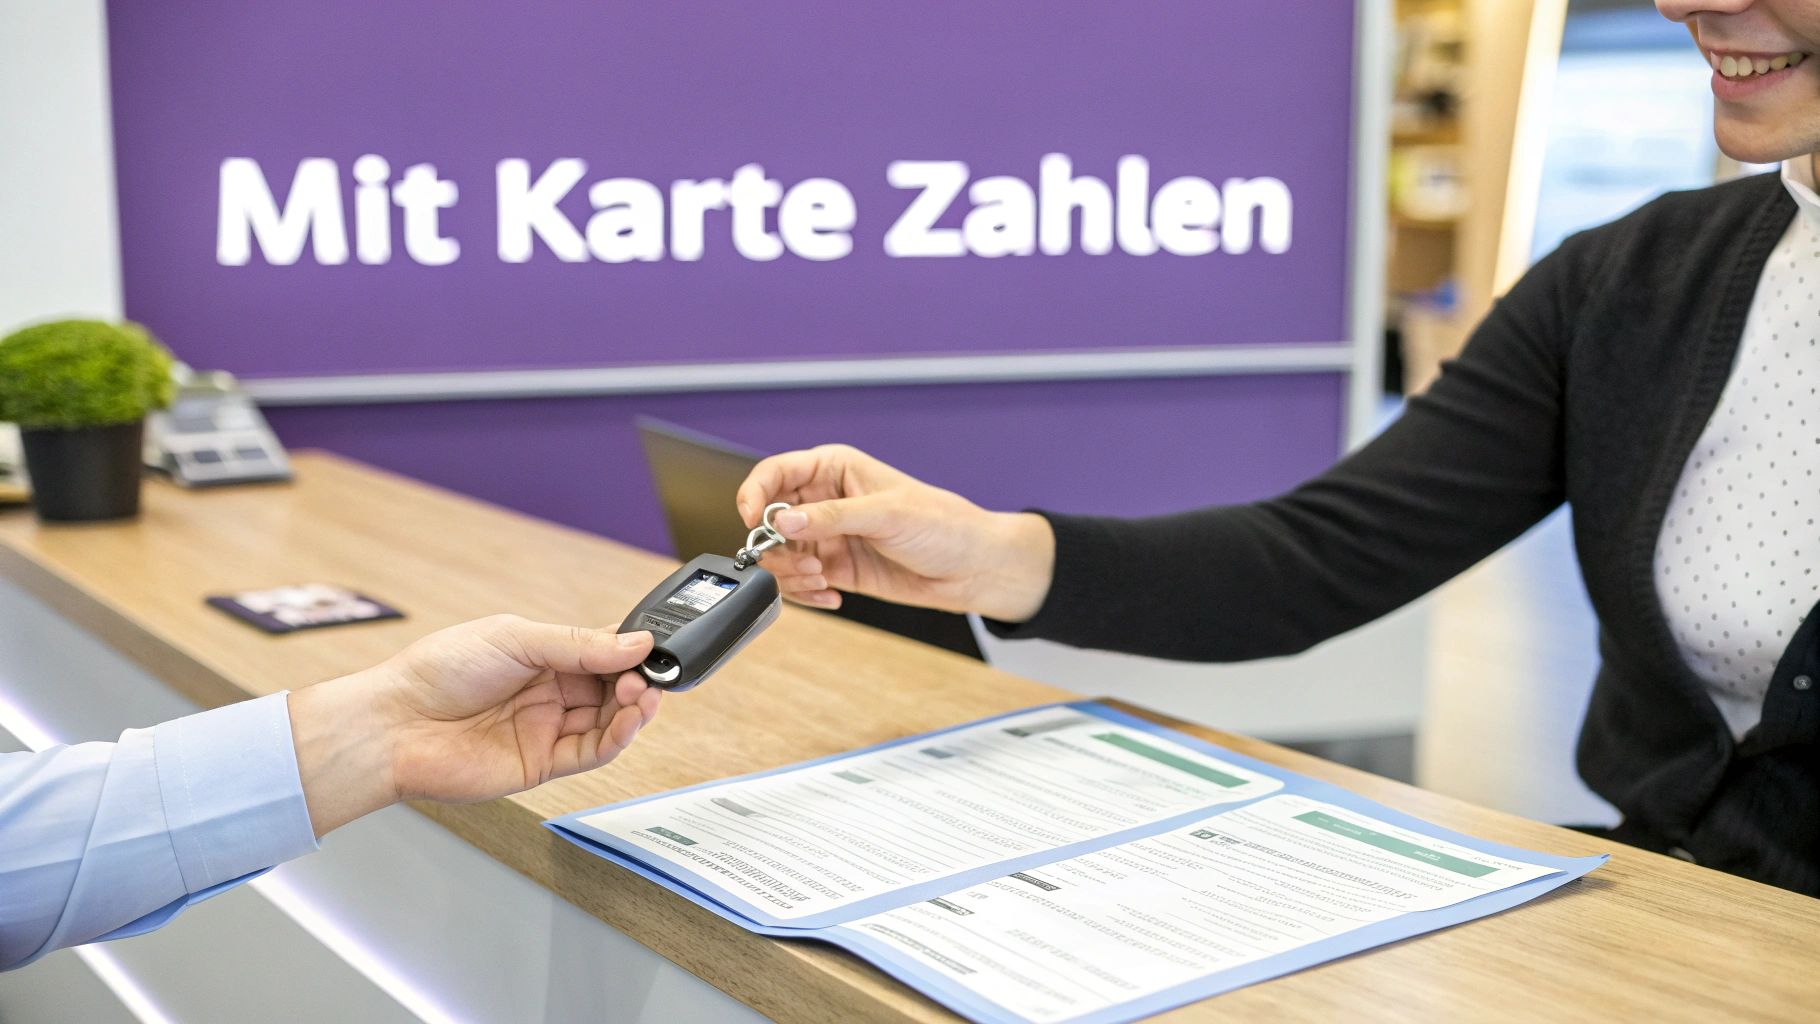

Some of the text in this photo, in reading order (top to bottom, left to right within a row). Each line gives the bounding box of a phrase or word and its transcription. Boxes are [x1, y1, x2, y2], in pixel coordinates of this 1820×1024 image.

[217, 153, 1293, 267] Mit Karte Zahlen
